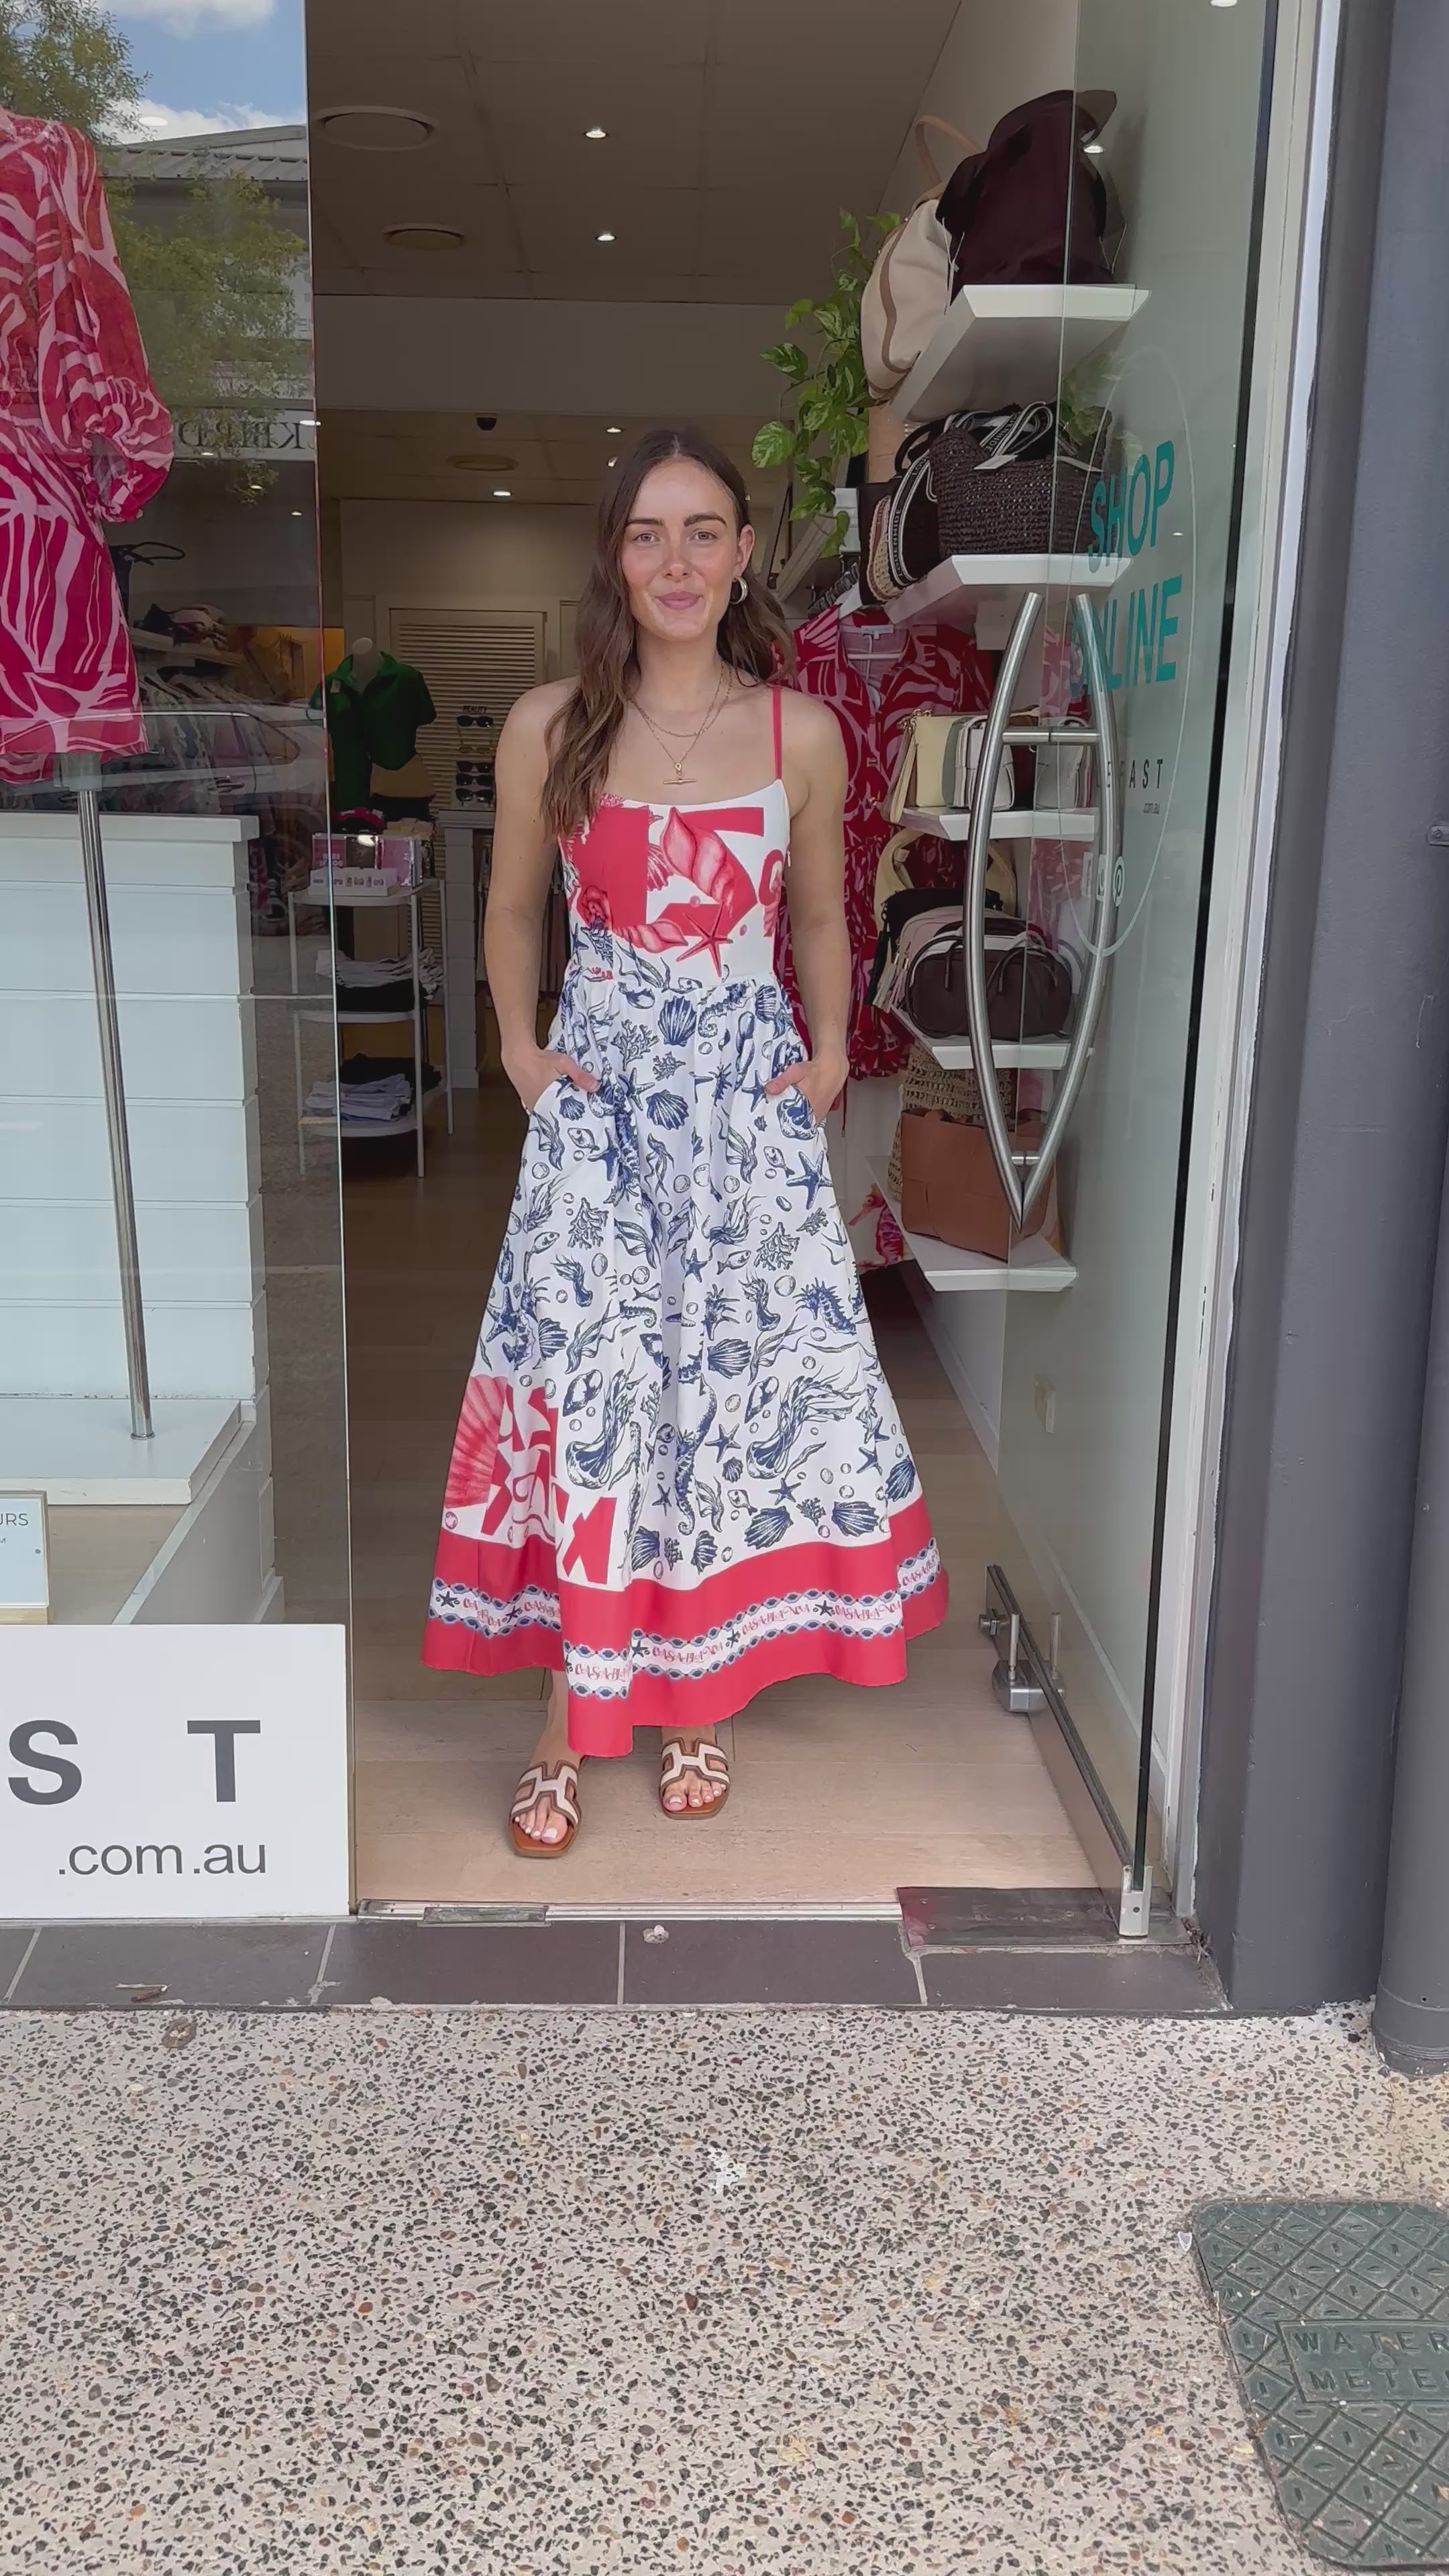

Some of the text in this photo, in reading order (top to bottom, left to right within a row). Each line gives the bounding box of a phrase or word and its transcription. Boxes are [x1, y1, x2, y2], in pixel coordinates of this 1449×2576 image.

[1087, 440, 1175, 573] SHOP
[59, 1844, 266, 1875] .com.au
[1293, 2330, 1449, 2353] WATER
